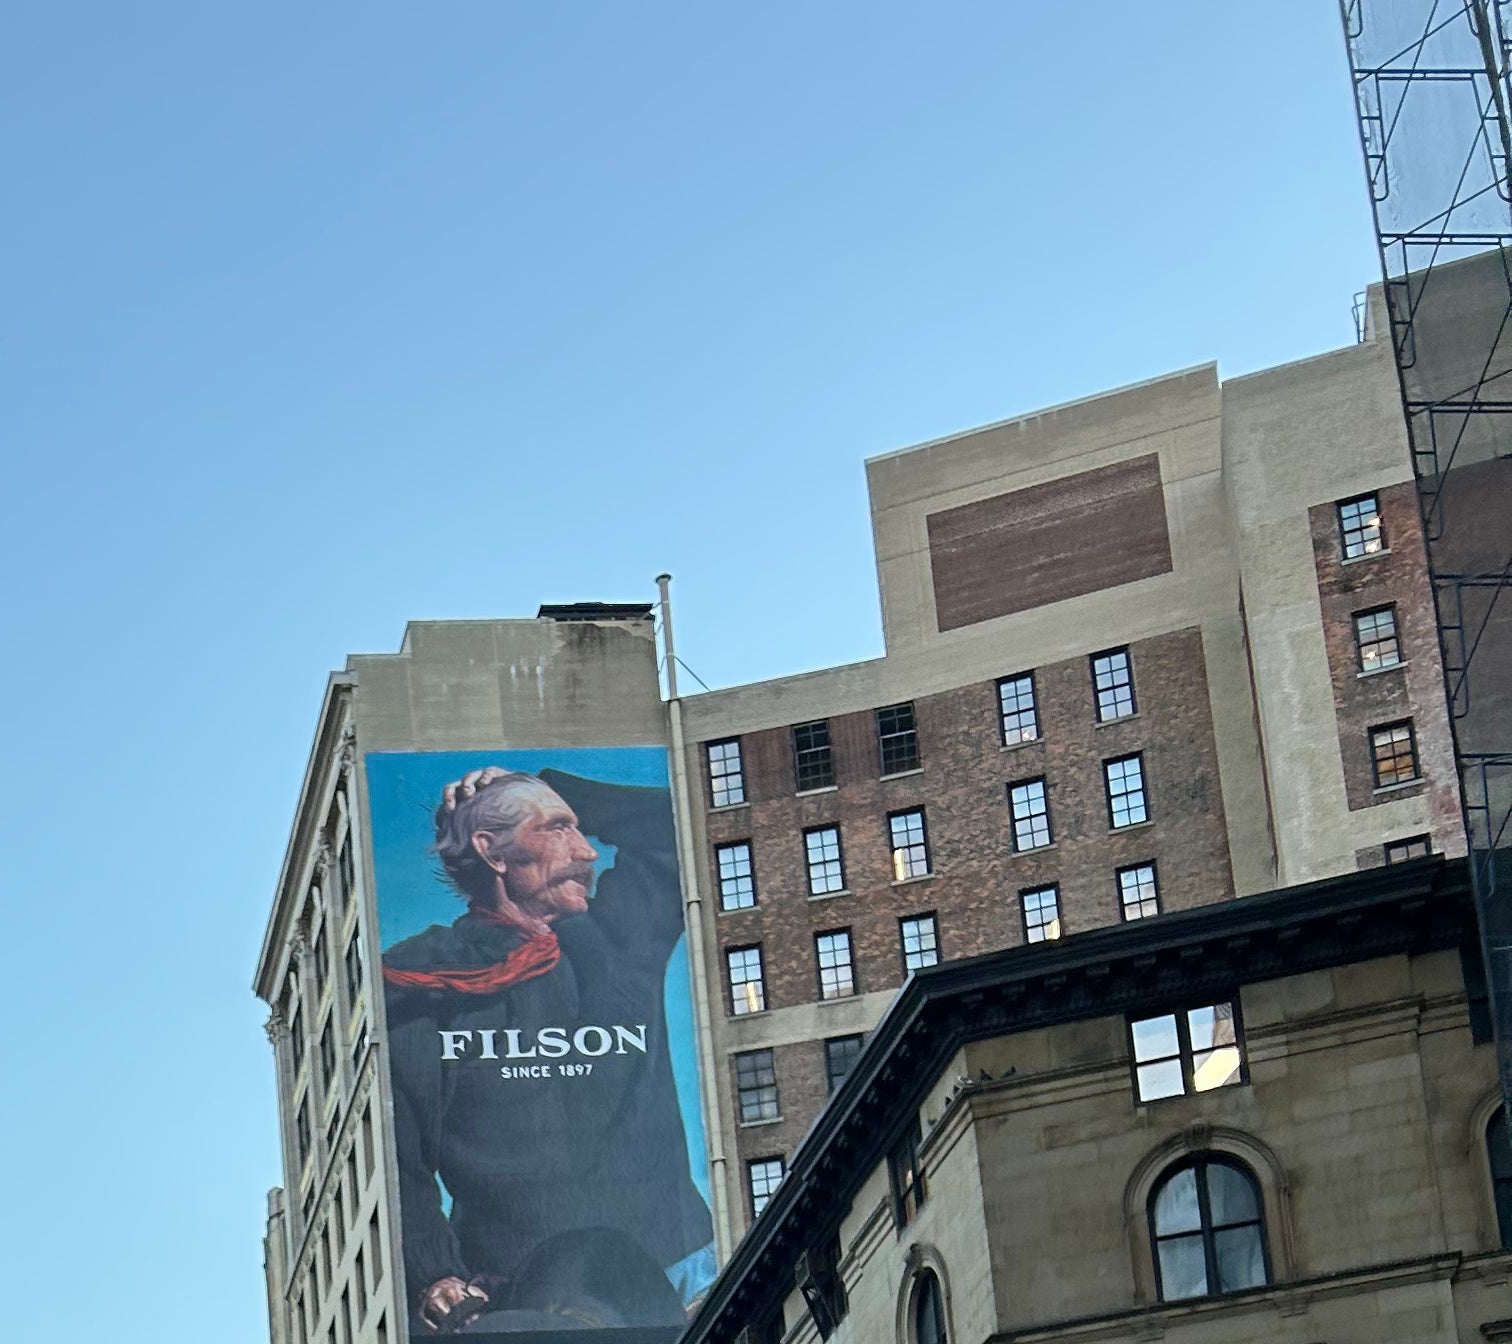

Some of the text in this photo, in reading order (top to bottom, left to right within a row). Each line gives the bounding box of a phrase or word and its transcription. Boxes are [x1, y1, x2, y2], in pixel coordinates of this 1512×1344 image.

[438, 1024, 648, 1060] FILSON
[500, 1063, 593, 1080] SINCE 1897
